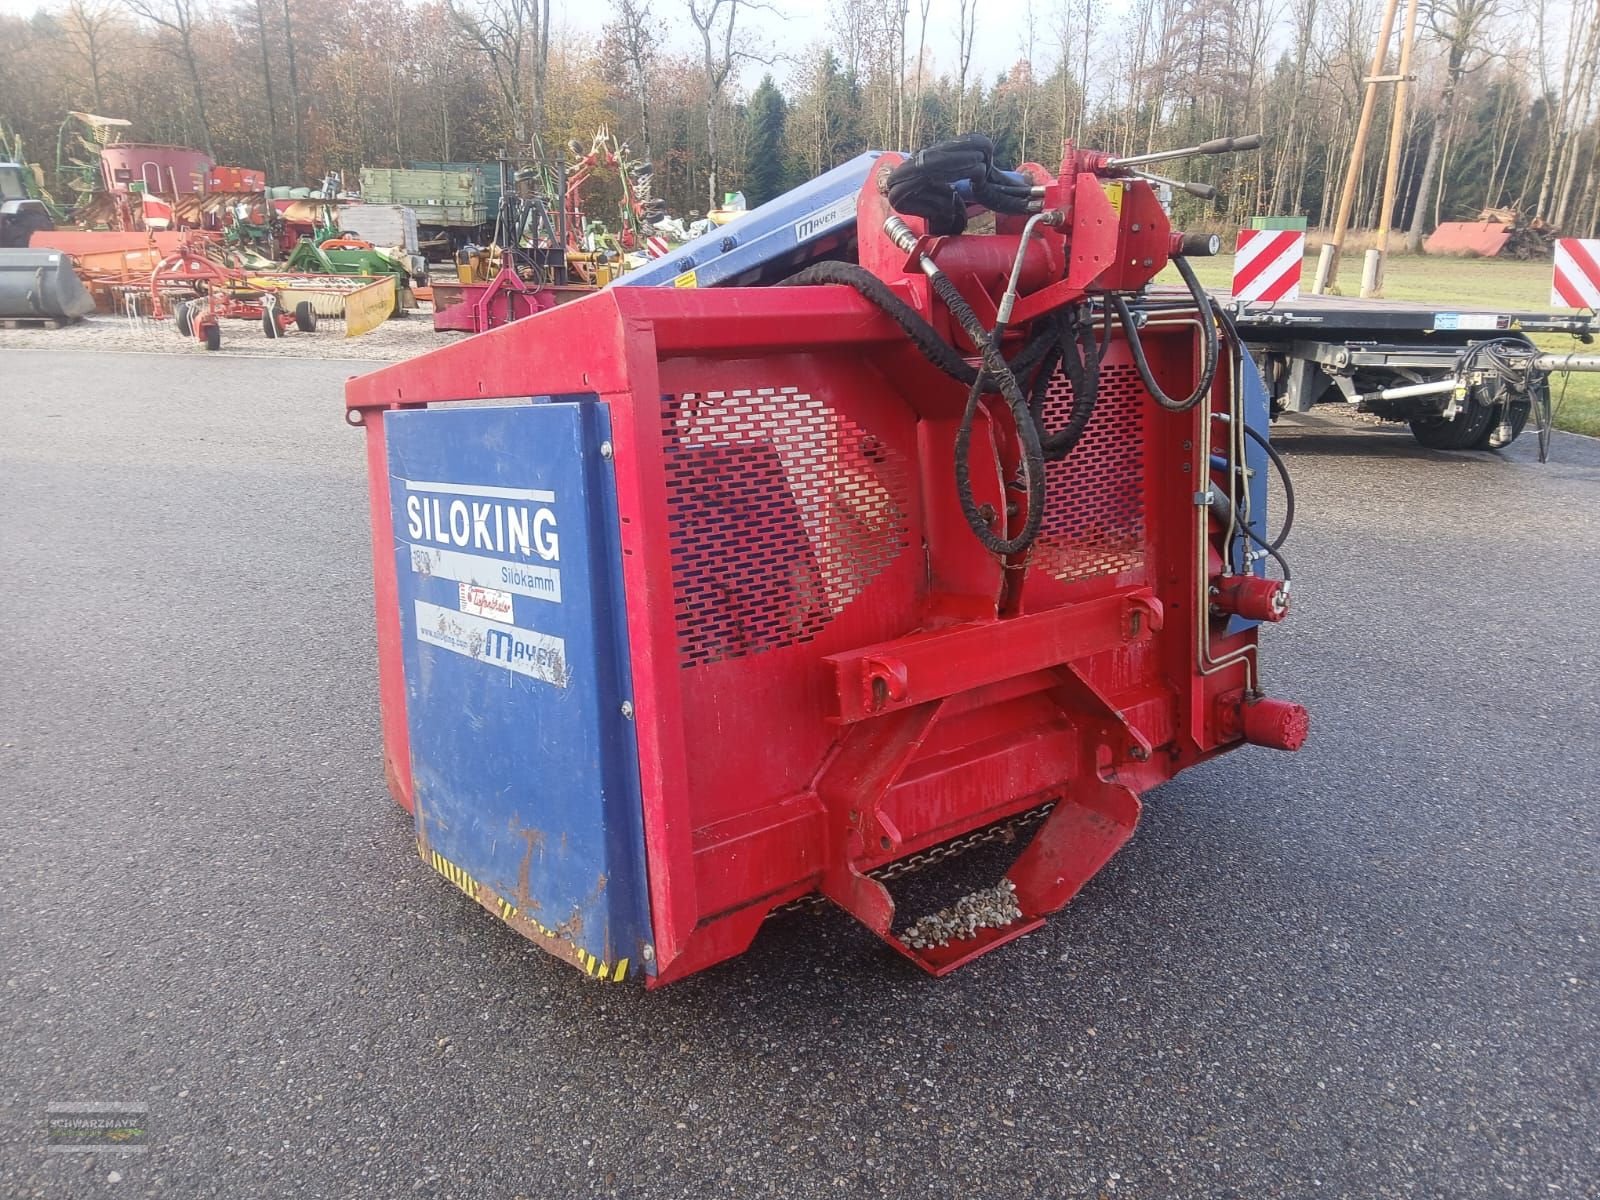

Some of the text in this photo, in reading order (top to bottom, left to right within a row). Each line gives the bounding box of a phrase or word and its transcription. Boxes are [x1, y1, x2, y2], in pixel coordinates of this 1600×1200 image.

[799, 211, 836, 239] MAYER
[407, 495, 560, 561] SILOKING
[501, 566, 555, 592] Silokamm
